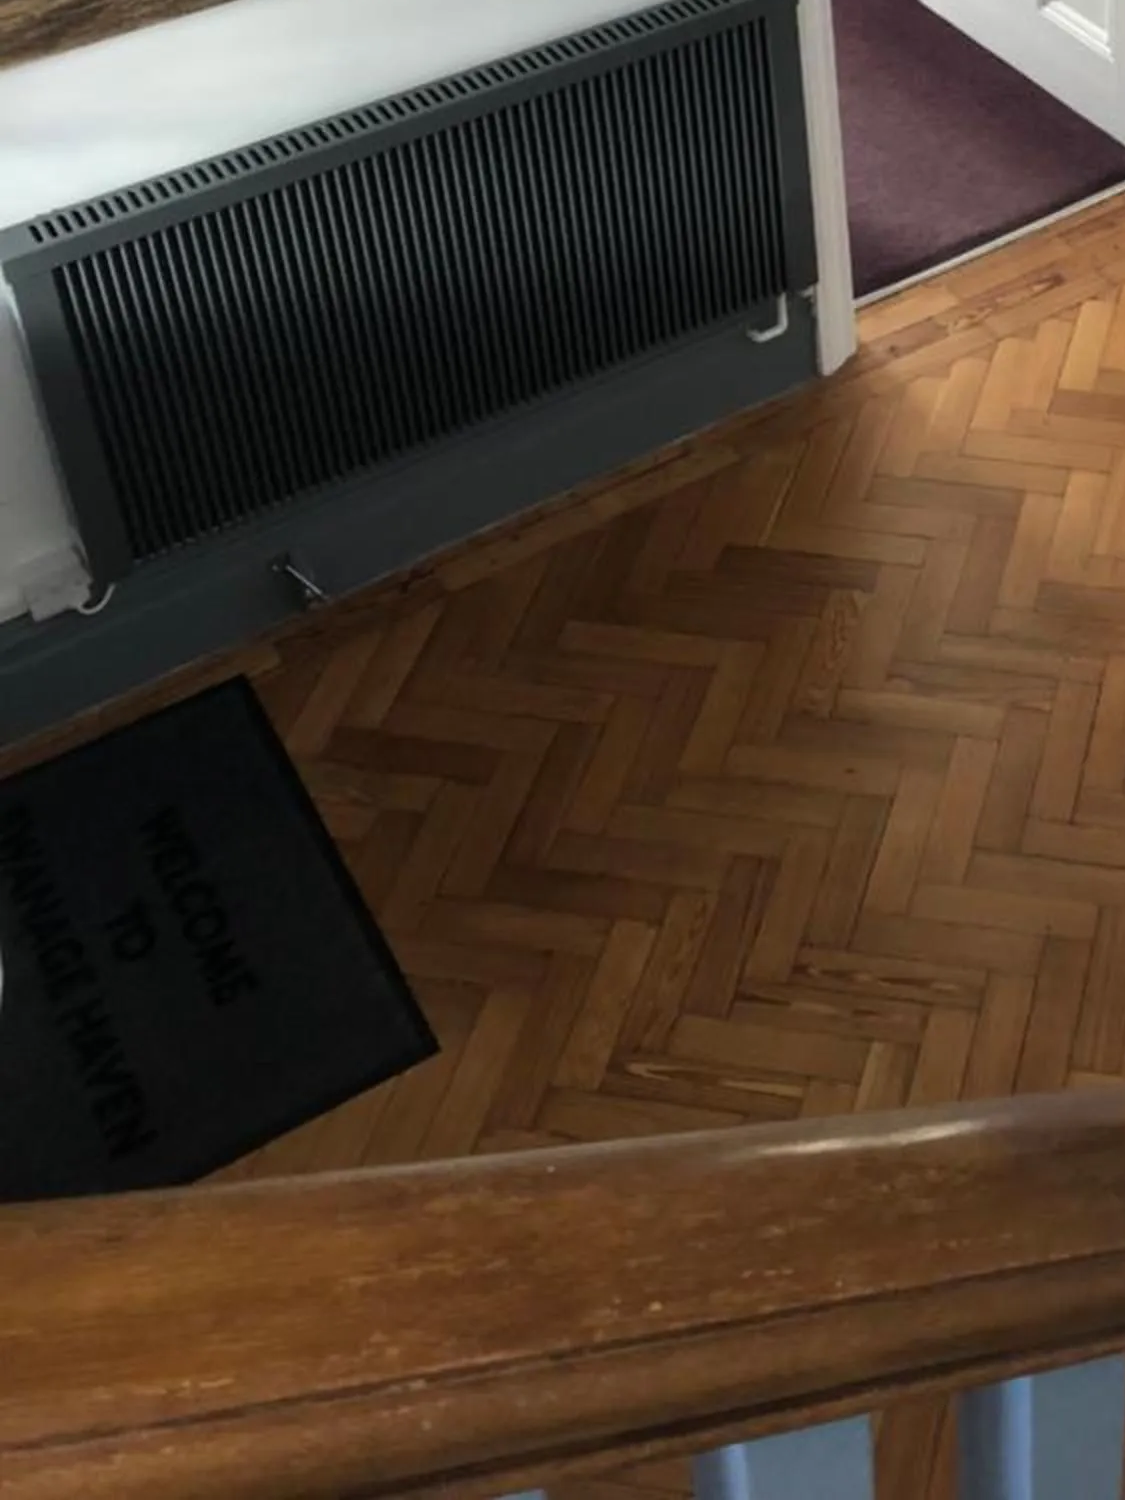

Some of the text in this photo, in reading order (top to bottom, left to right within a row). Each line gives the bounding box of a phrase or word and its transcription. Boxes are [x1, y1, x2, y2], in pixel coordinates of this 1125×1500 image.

[104, 894, 158, 965] TO
[138, 804, 263, 1010] WELCOME
[55, 996, 160, 1164] HAVEN
